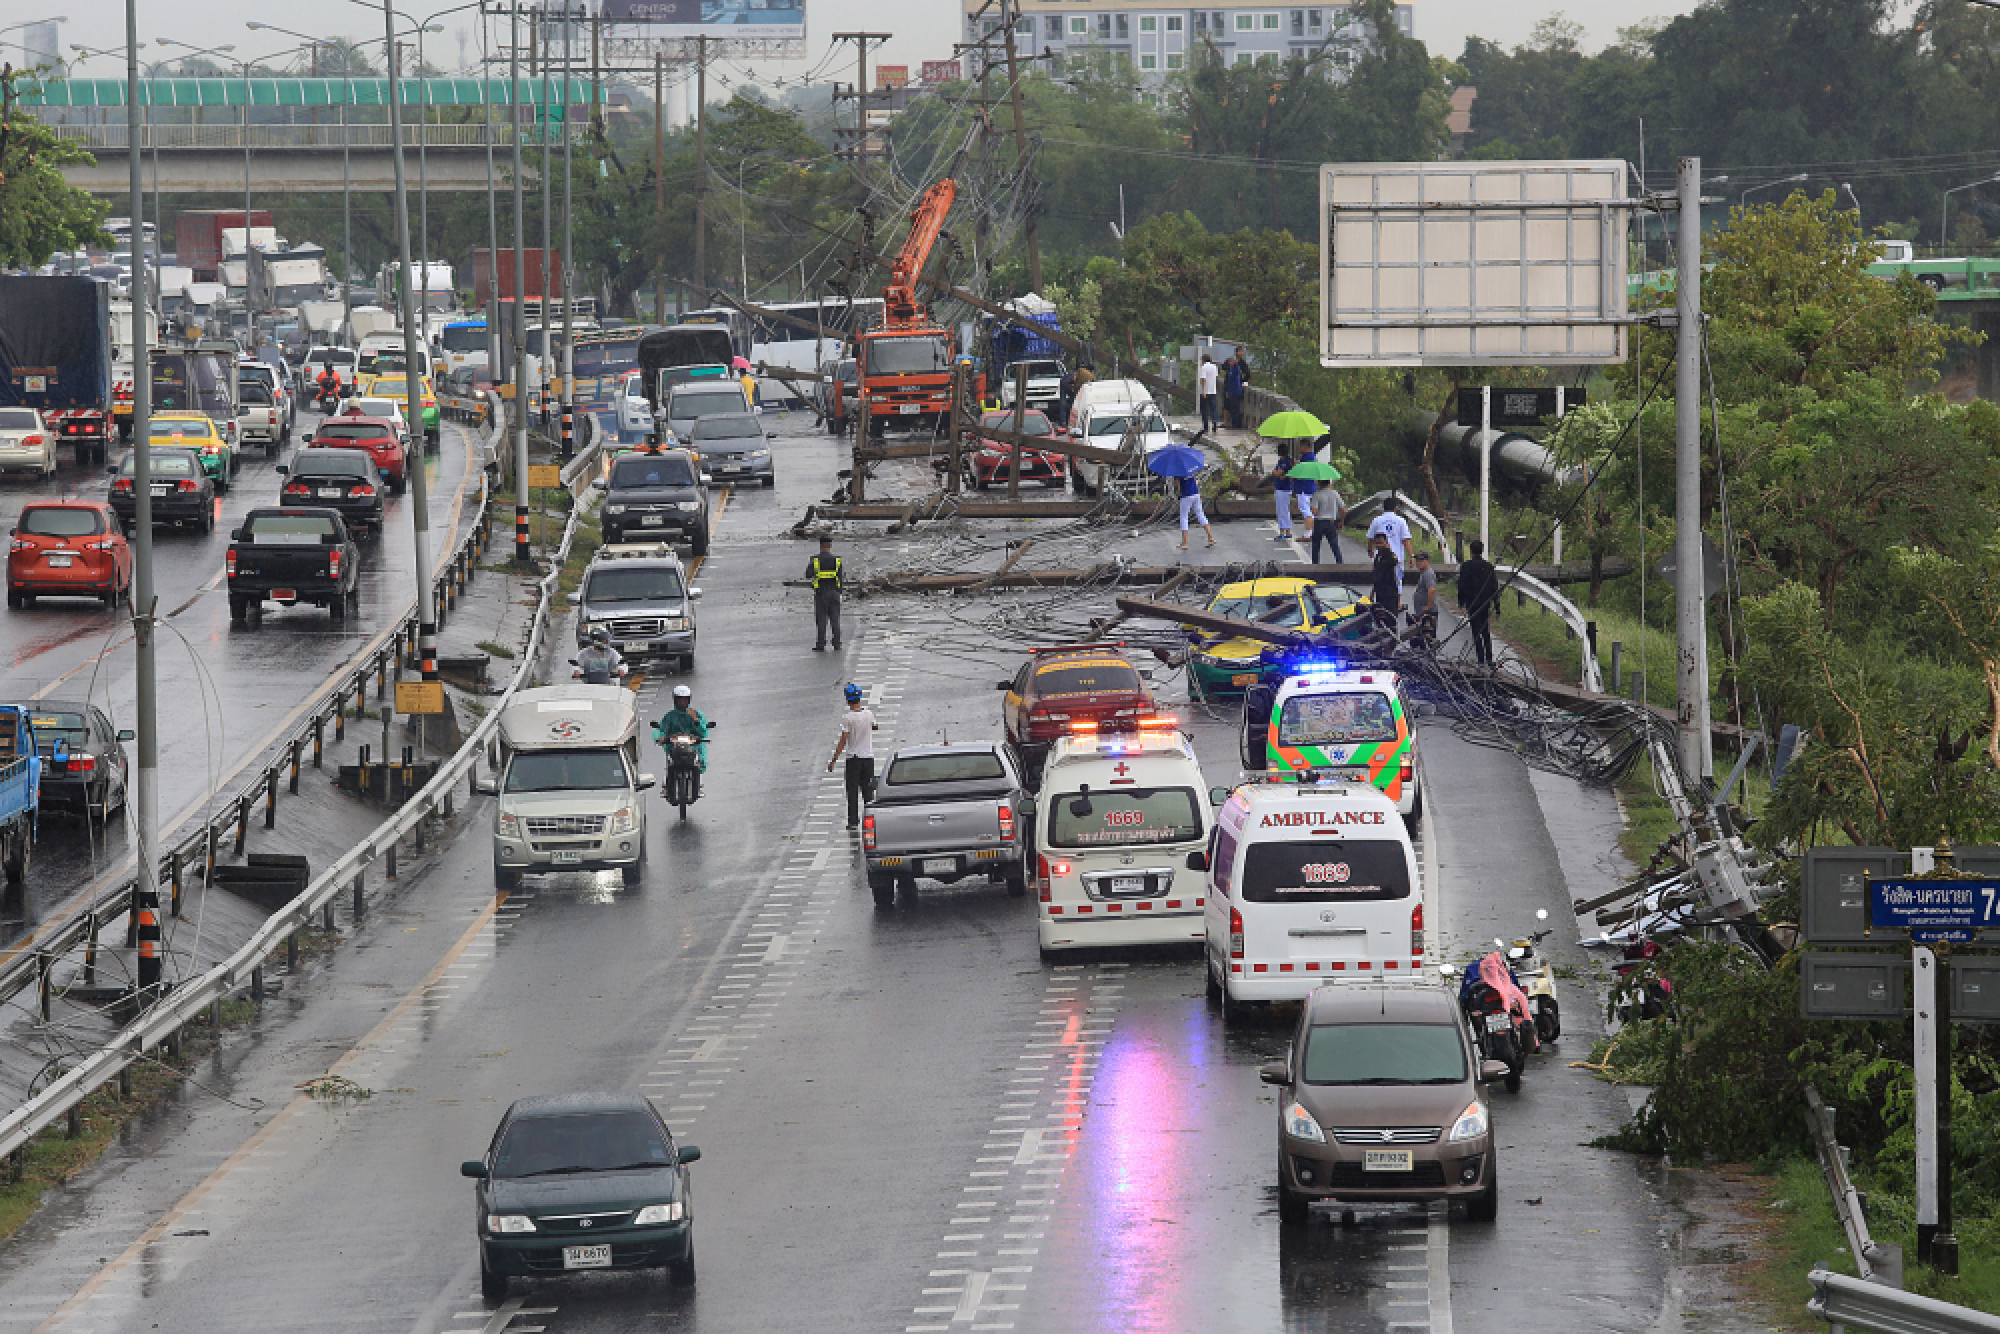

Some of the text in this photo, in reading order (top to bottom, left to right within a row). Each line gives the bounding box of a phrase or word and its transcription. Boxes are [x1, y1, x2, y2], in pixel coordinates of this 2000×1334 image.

[629, 3, 677, 14] CENTRO
[1104, 809, 1145, 827] 1669
[1259, 811, 1386, 828] AMBULANCE
[1301, 862, 1351, 883] 1669
